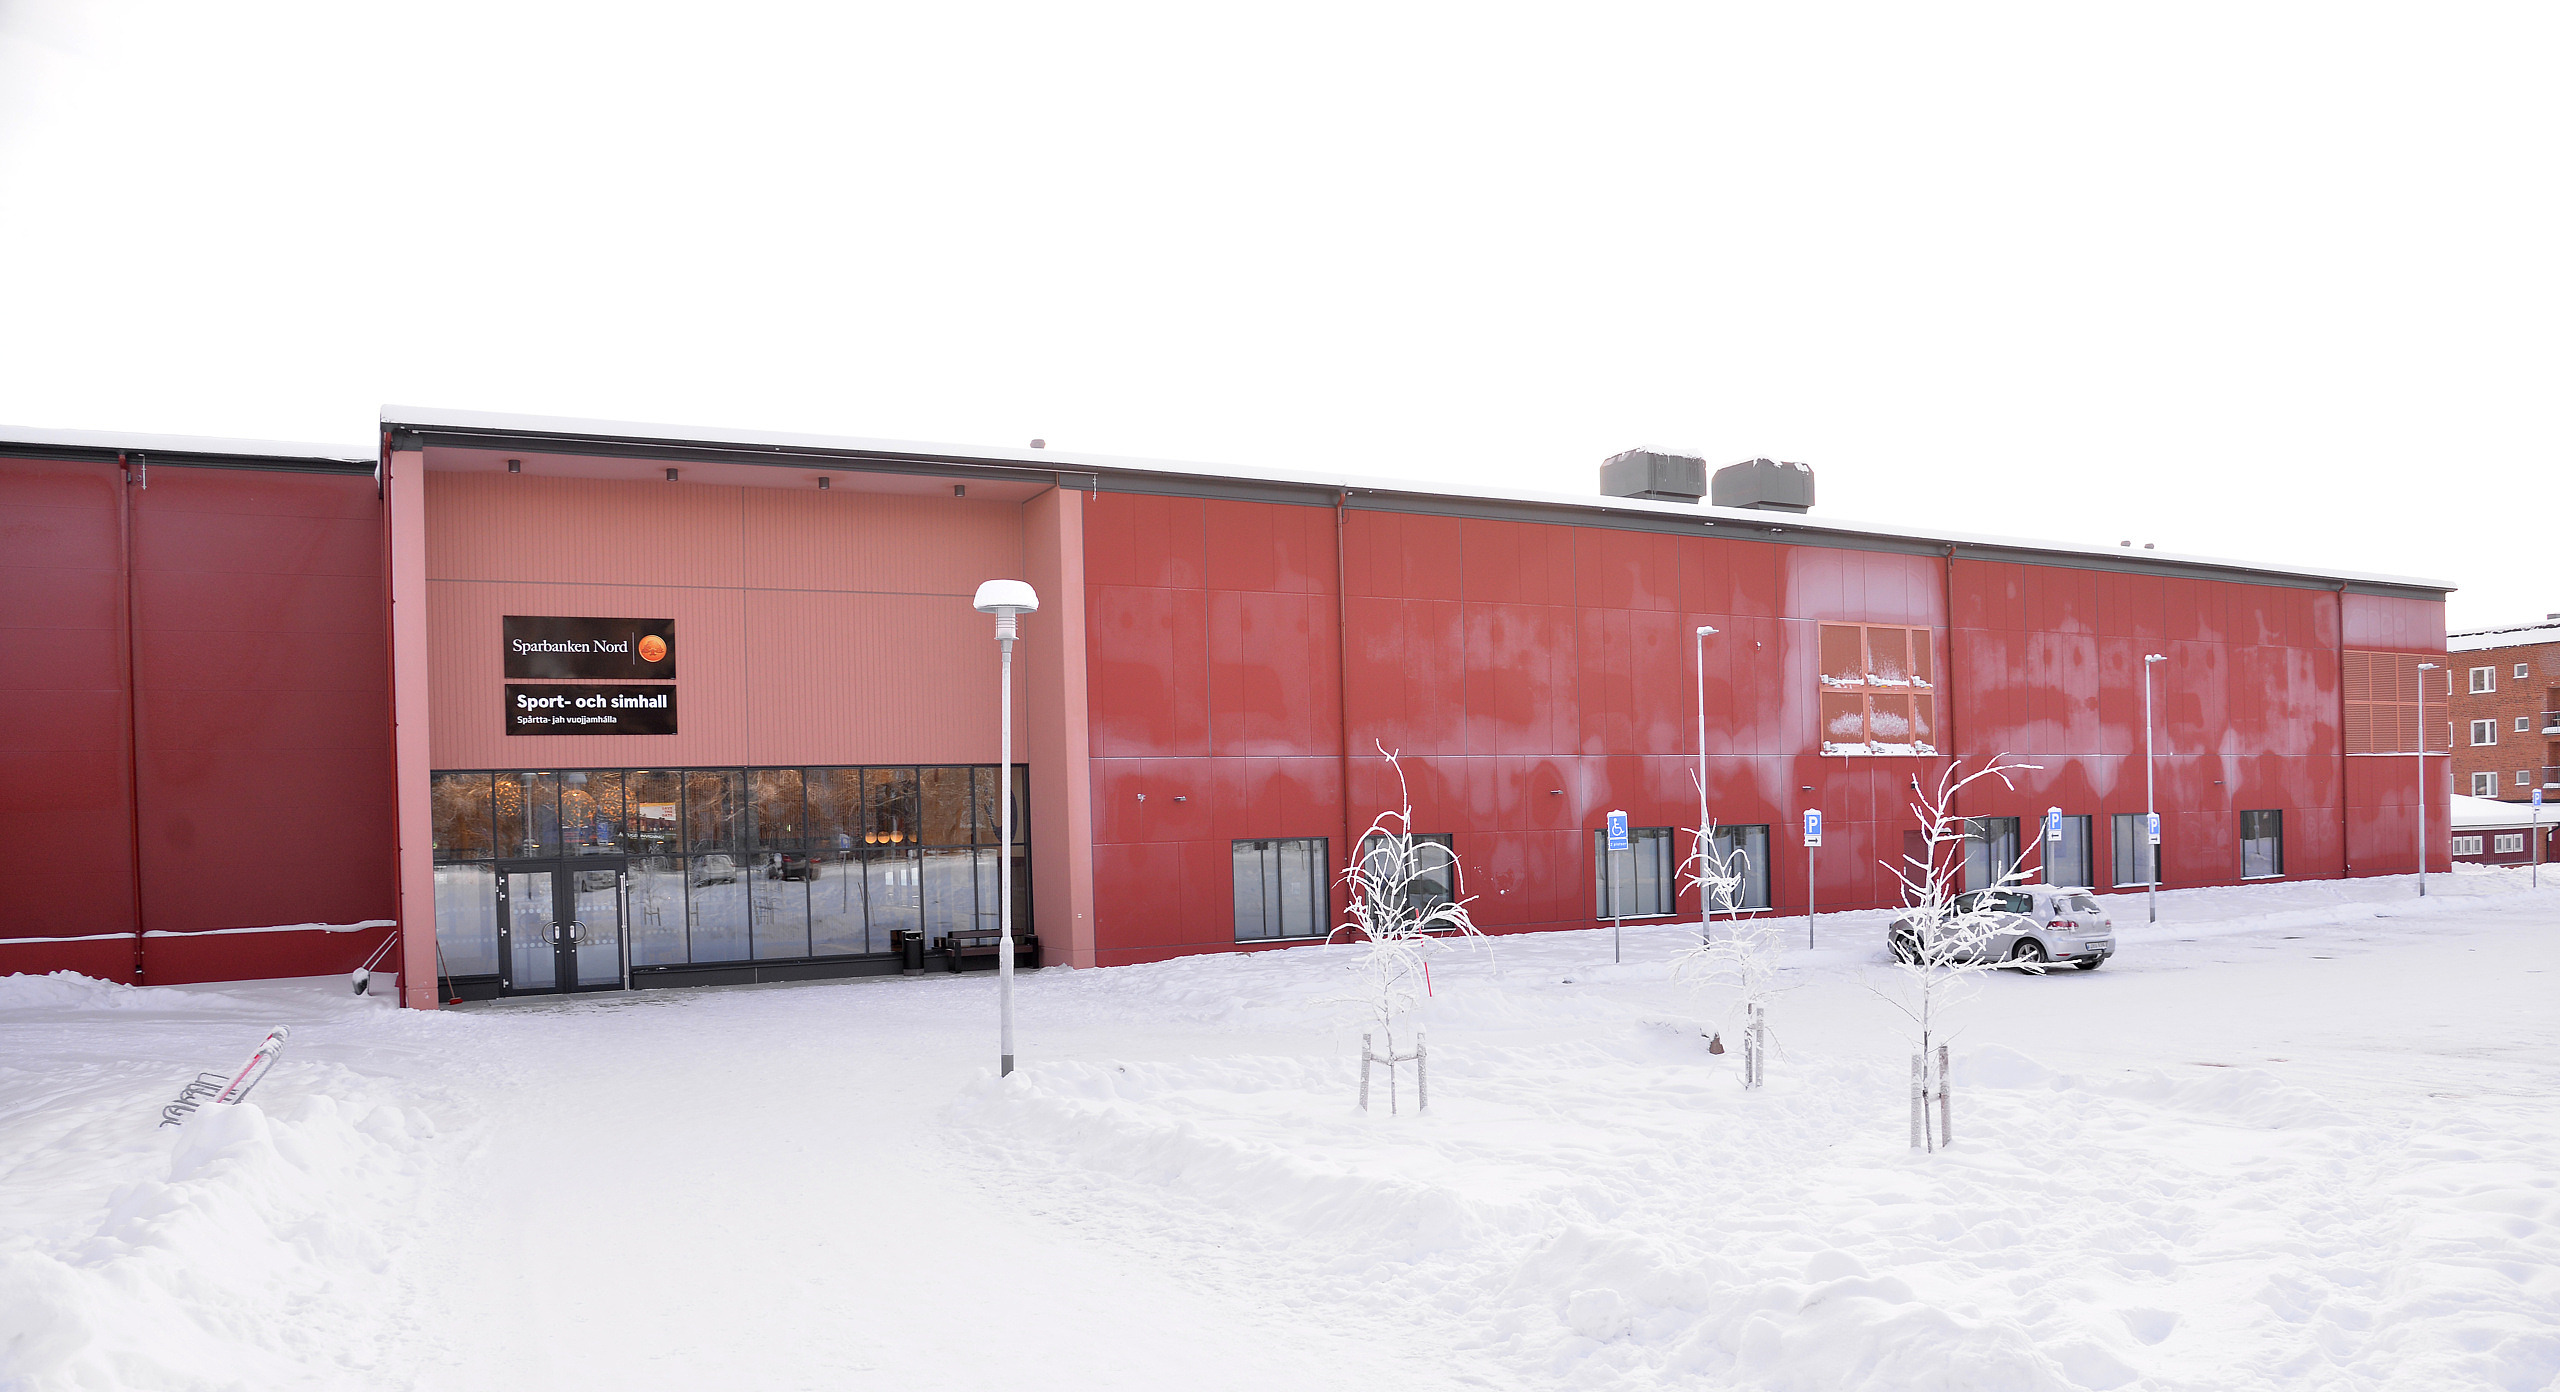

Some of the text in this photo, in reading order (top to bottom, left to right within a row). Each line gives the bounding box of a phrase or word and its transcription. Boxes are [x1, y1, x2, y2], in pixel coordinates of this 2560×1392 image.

[513, 638, 628, 655] Sparbanken Nord
[517, 693, 667, 711] Sport- och simhall
[551, 715, 566, 725] jah
[2534, 793, 2540, 804] P
[1808, 815, 1819, 833] P
[2051, 812, 2060, 829] P
[2150, 818, 2158, 833] P
